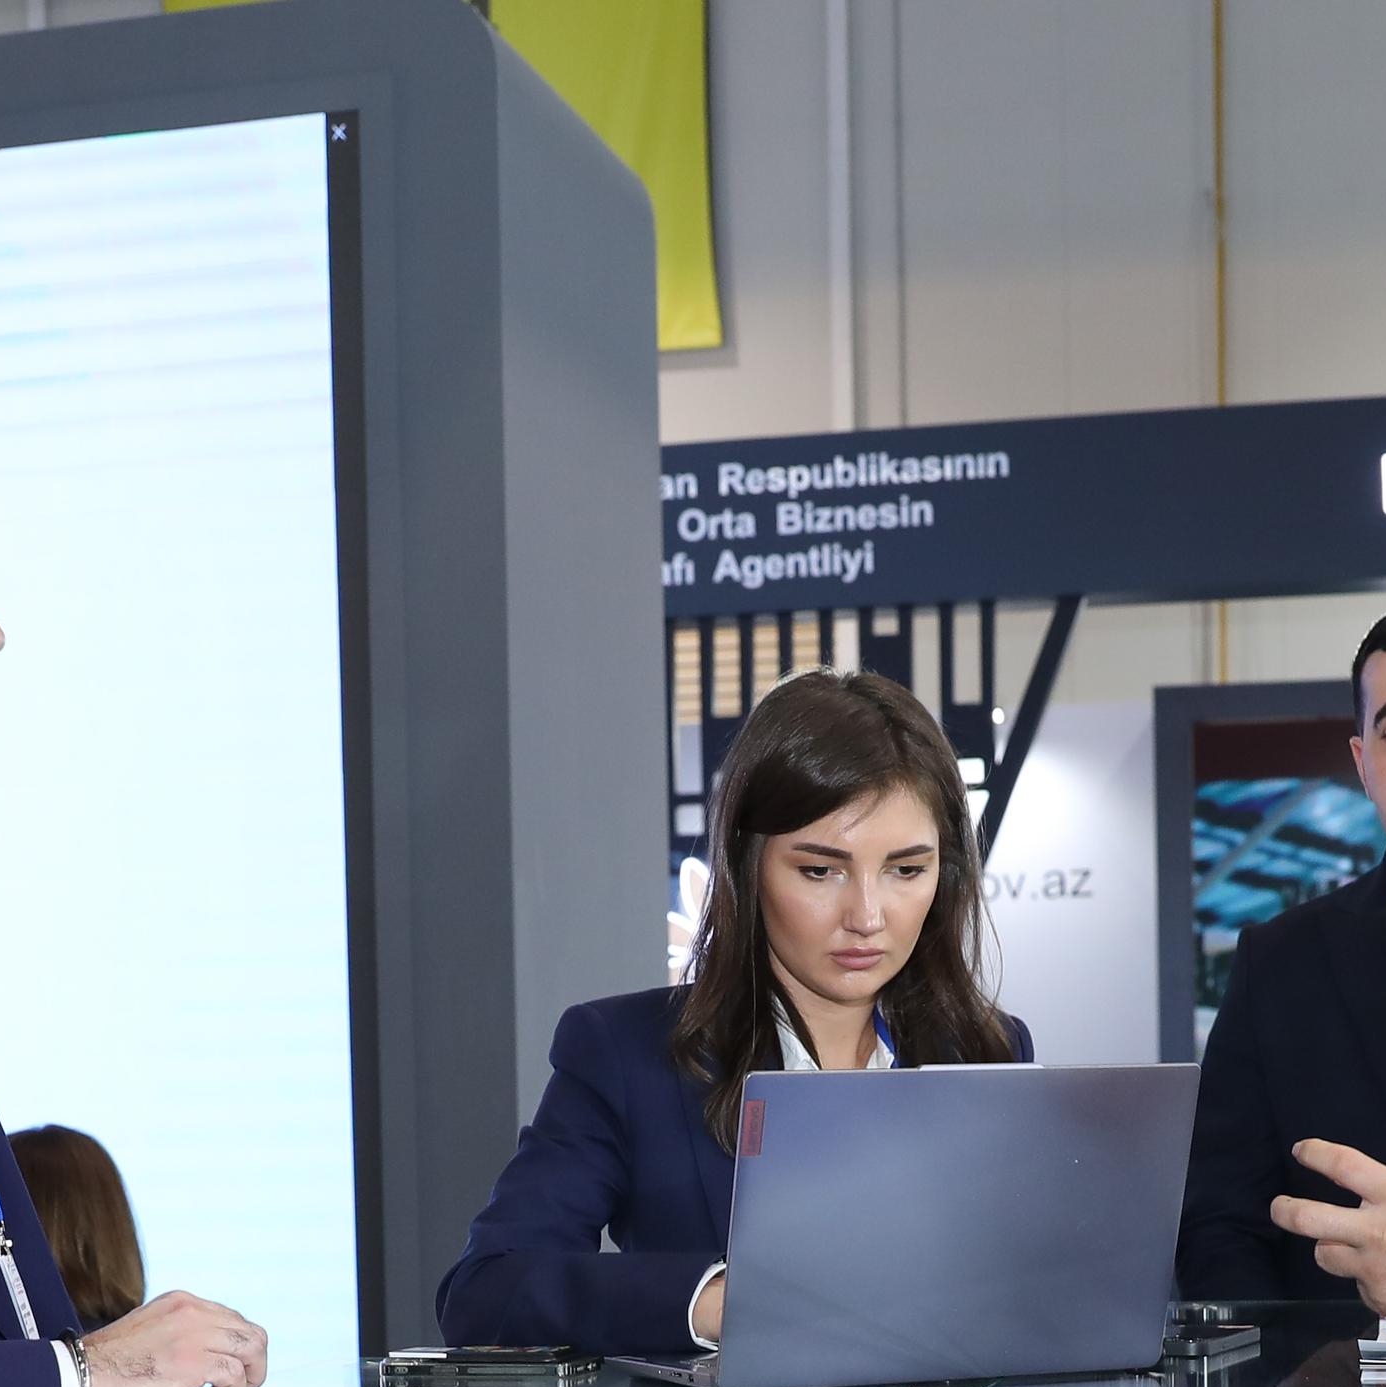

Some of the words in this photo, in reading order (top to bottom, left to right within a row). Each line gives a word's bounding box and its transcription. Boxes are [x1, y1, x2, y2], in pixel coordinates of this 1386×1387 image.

[718, 450, 1010, 499] Respublikasının
[677, 507, 757, 542] Orta
[776, 495, 935, 536] Biznesin
[712, 541, 875, 590] Agentliyi
